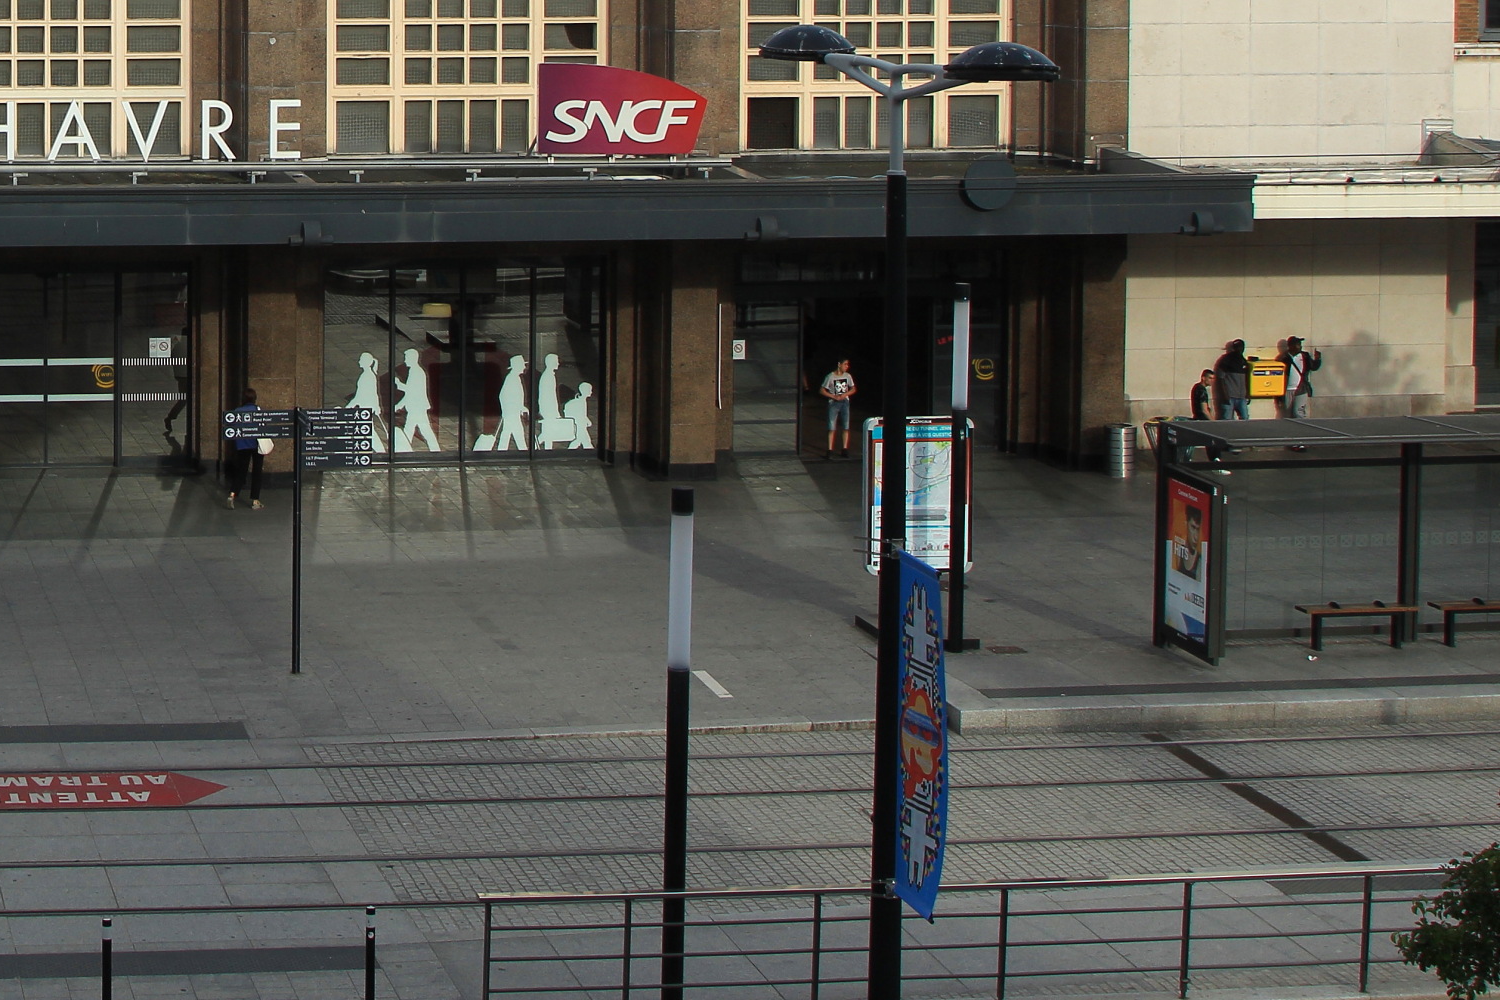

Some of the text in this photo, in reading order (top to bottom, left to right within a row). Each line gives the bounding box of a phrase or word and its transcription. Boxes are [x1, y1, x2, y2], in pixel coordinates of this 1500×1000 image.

[545, 100, 697, 143] SNCF
[1174, 542, 1189, 561] HITS
[120, 774, 168, 785] AU
